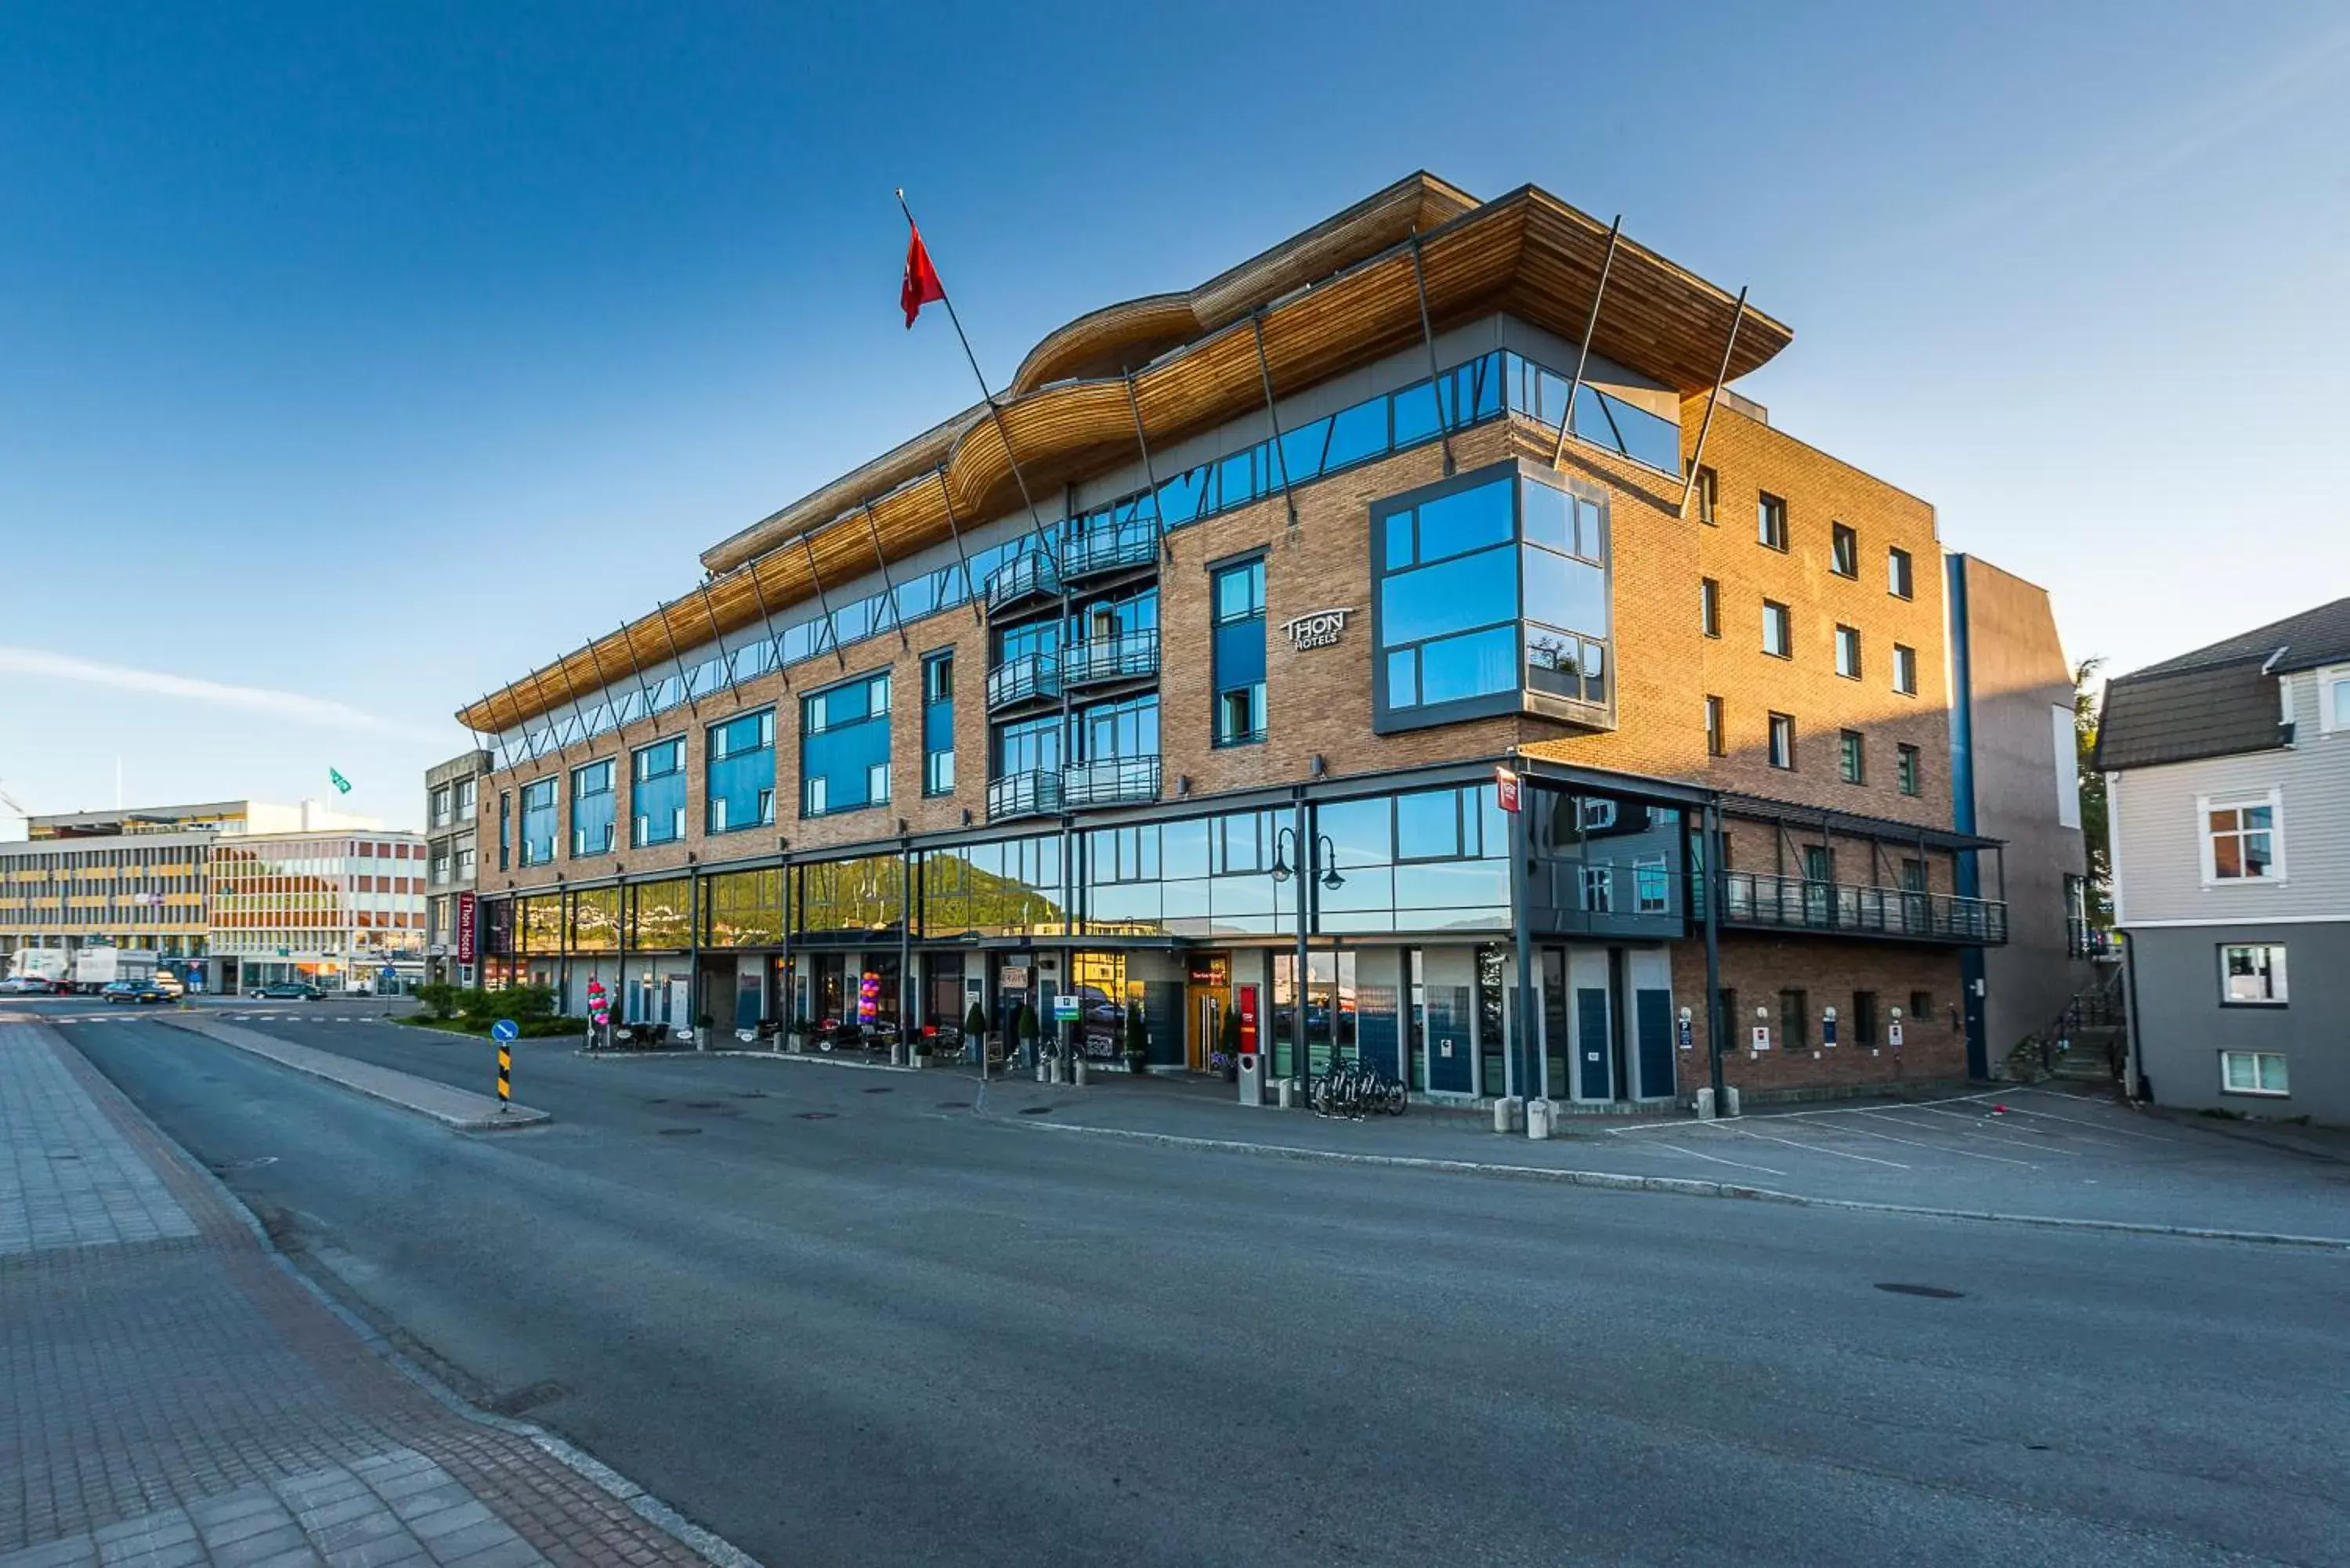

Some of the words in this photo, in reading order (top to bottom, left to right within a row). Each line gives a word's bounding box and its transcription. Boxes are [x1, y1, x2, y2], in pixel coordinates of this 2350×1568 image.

[1280, 607, 1355, 641] THON
[1295, 634, 1338, 652] HOTELS
[462, 903, 473, 927] Thon
[461, 928, 472, 959] Hotels
